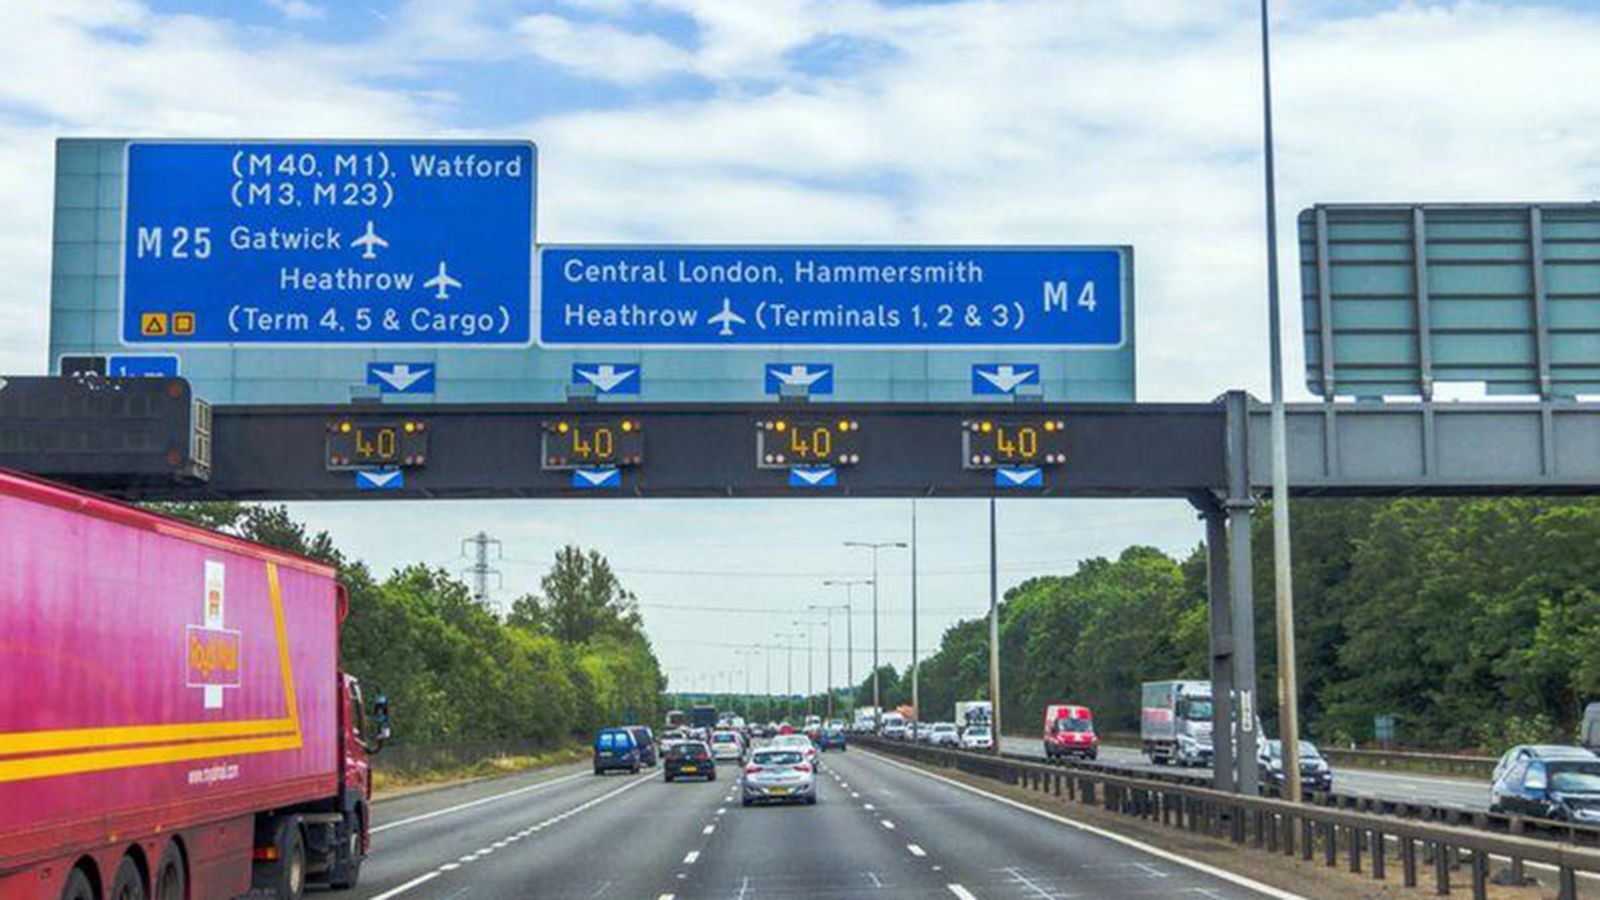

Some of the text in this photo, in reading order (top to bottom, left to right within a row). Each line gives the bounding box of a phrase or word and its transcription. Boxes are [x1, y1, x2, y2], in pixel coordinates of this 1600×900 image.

[411, 155, 521, 177] Watford
[230, 226, 341, 249] Gatwick
[280, 267, 414, 290] Heathrow
[564, 259, 983, 284] Central London, Hammersmith
[228, 305, 510, 335] (Term 4, 5 & Cargo)
[565, 302, 1025, 329] Heathrow (Terminals 1, 2 & 3)
[356, 429, 394, 458] 40
[573, 428, 612, 457] 40
[792, 428, 830, 457] 40
[998, 428, 1036, 457] 40
